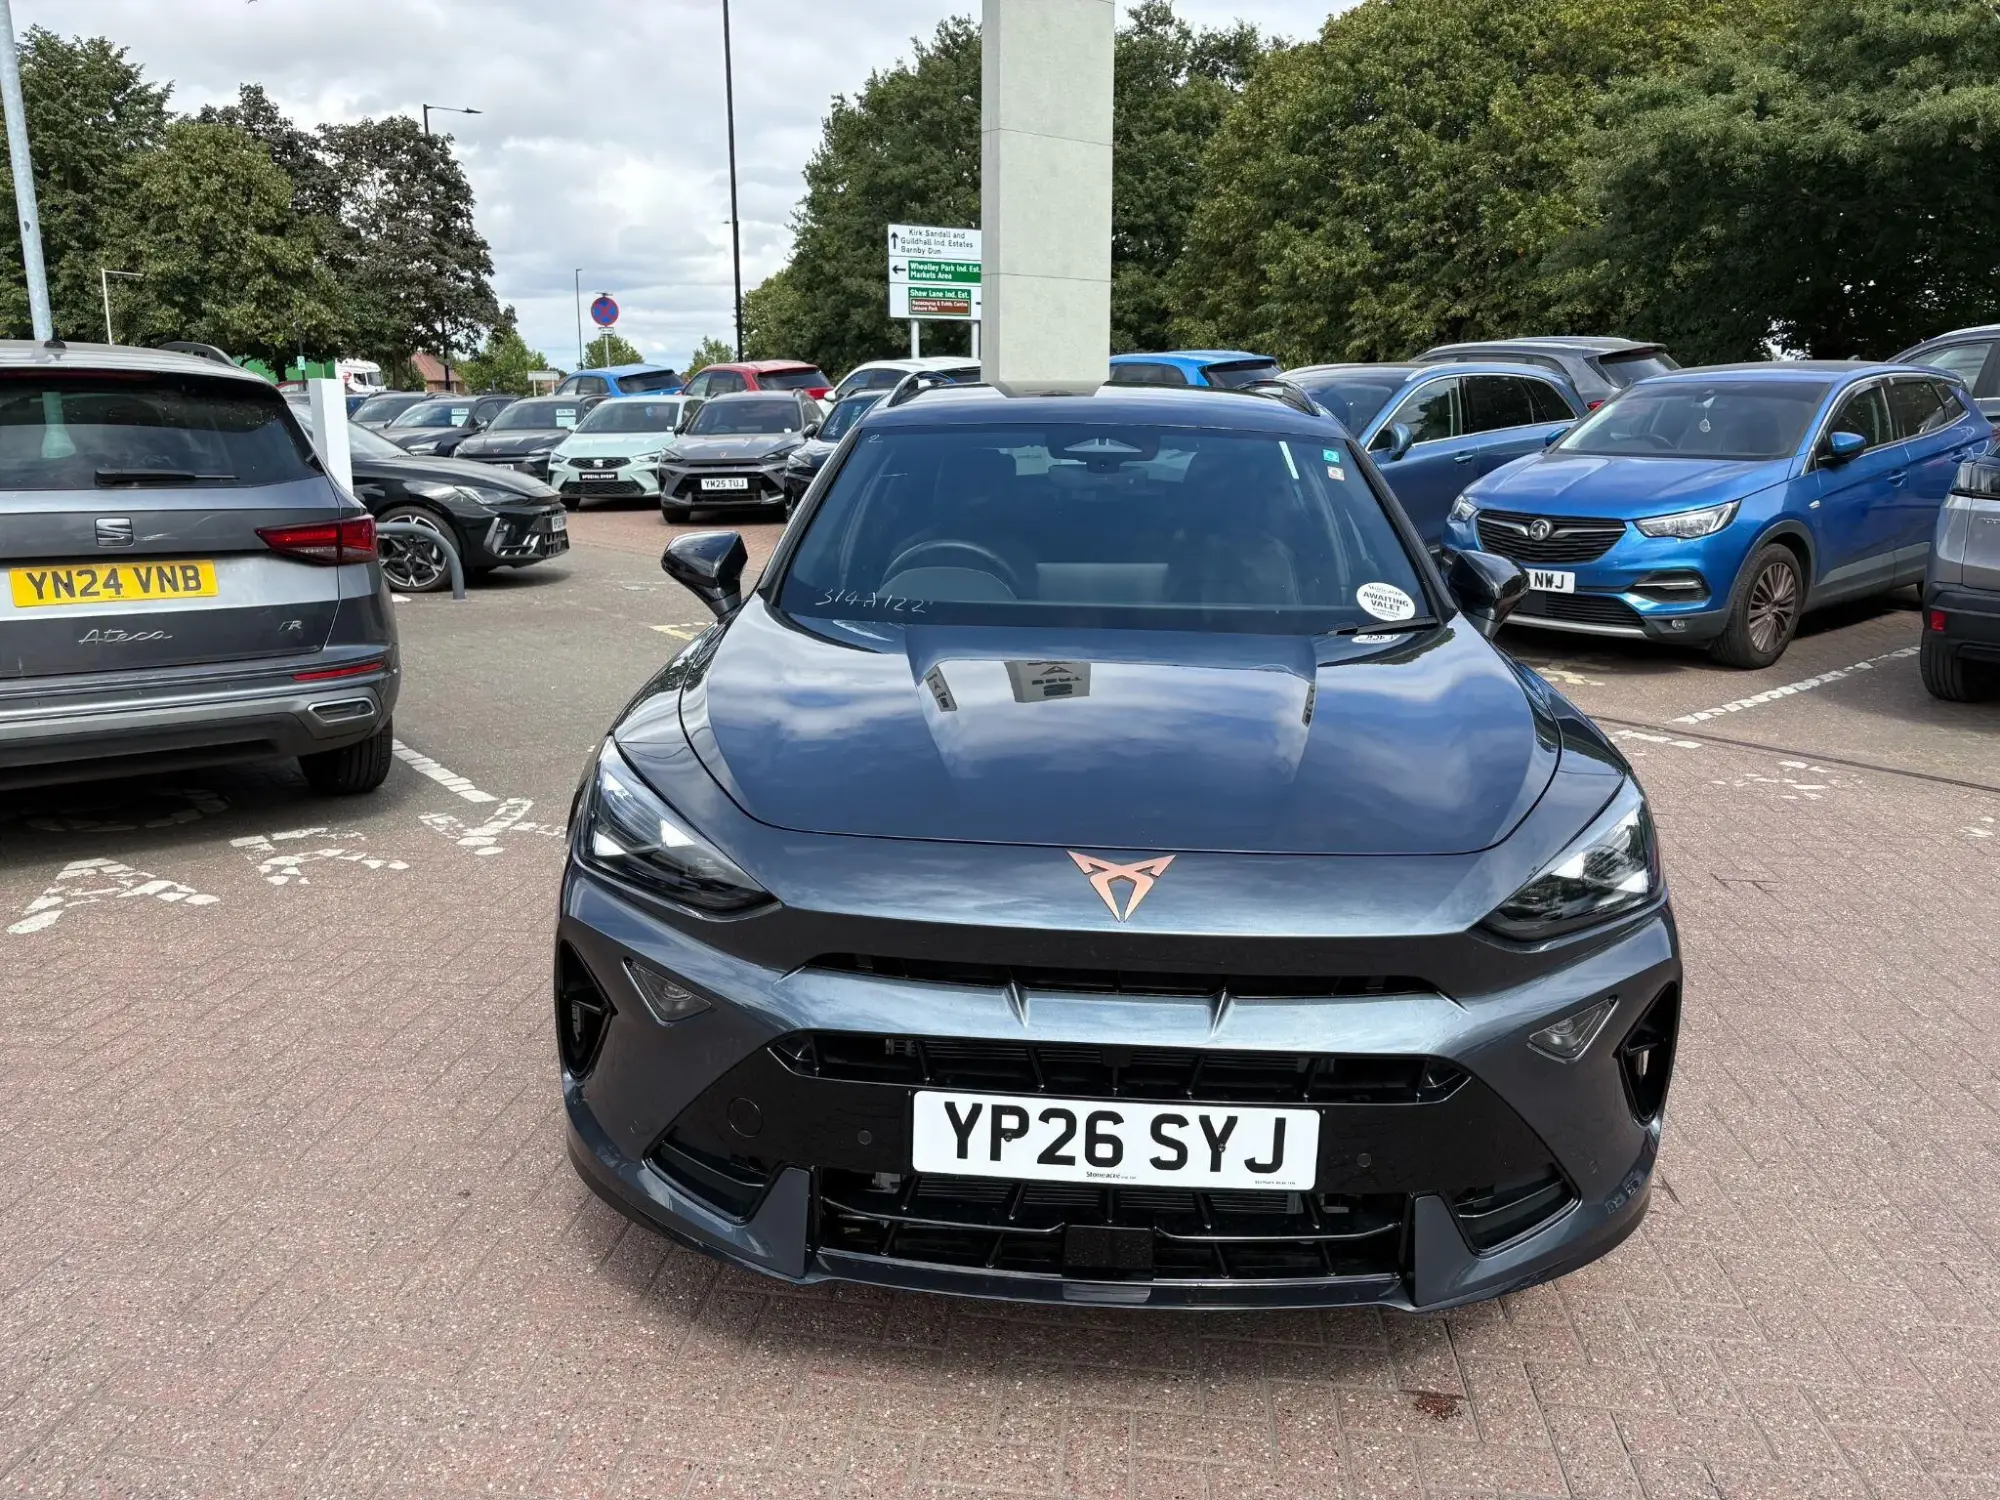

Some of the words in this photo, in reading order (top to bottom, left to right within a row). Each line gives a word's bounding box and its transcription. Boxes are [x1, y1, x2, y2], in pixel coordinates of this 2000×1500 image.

[926, 230, 951, 238] Sandall
[901, 246, 926, 255] Barnby
[910, 263, 938, 272] Wheatley
[728, 480, 745, 488] TUJ
[26, 568, 124, 600] YN24
[132, 564, 202, 593] VNB
[1534, 572, 1565, 589] NWJ
[1363, 591, 1409, 607] AWAITING
[1370, 599, 1400, 612] VALET
[79, 629, 173, 646] Ateca
[944, 1101, 1125, 1168] YP26
[1149, 1113, 1287, 1174] SYJ
